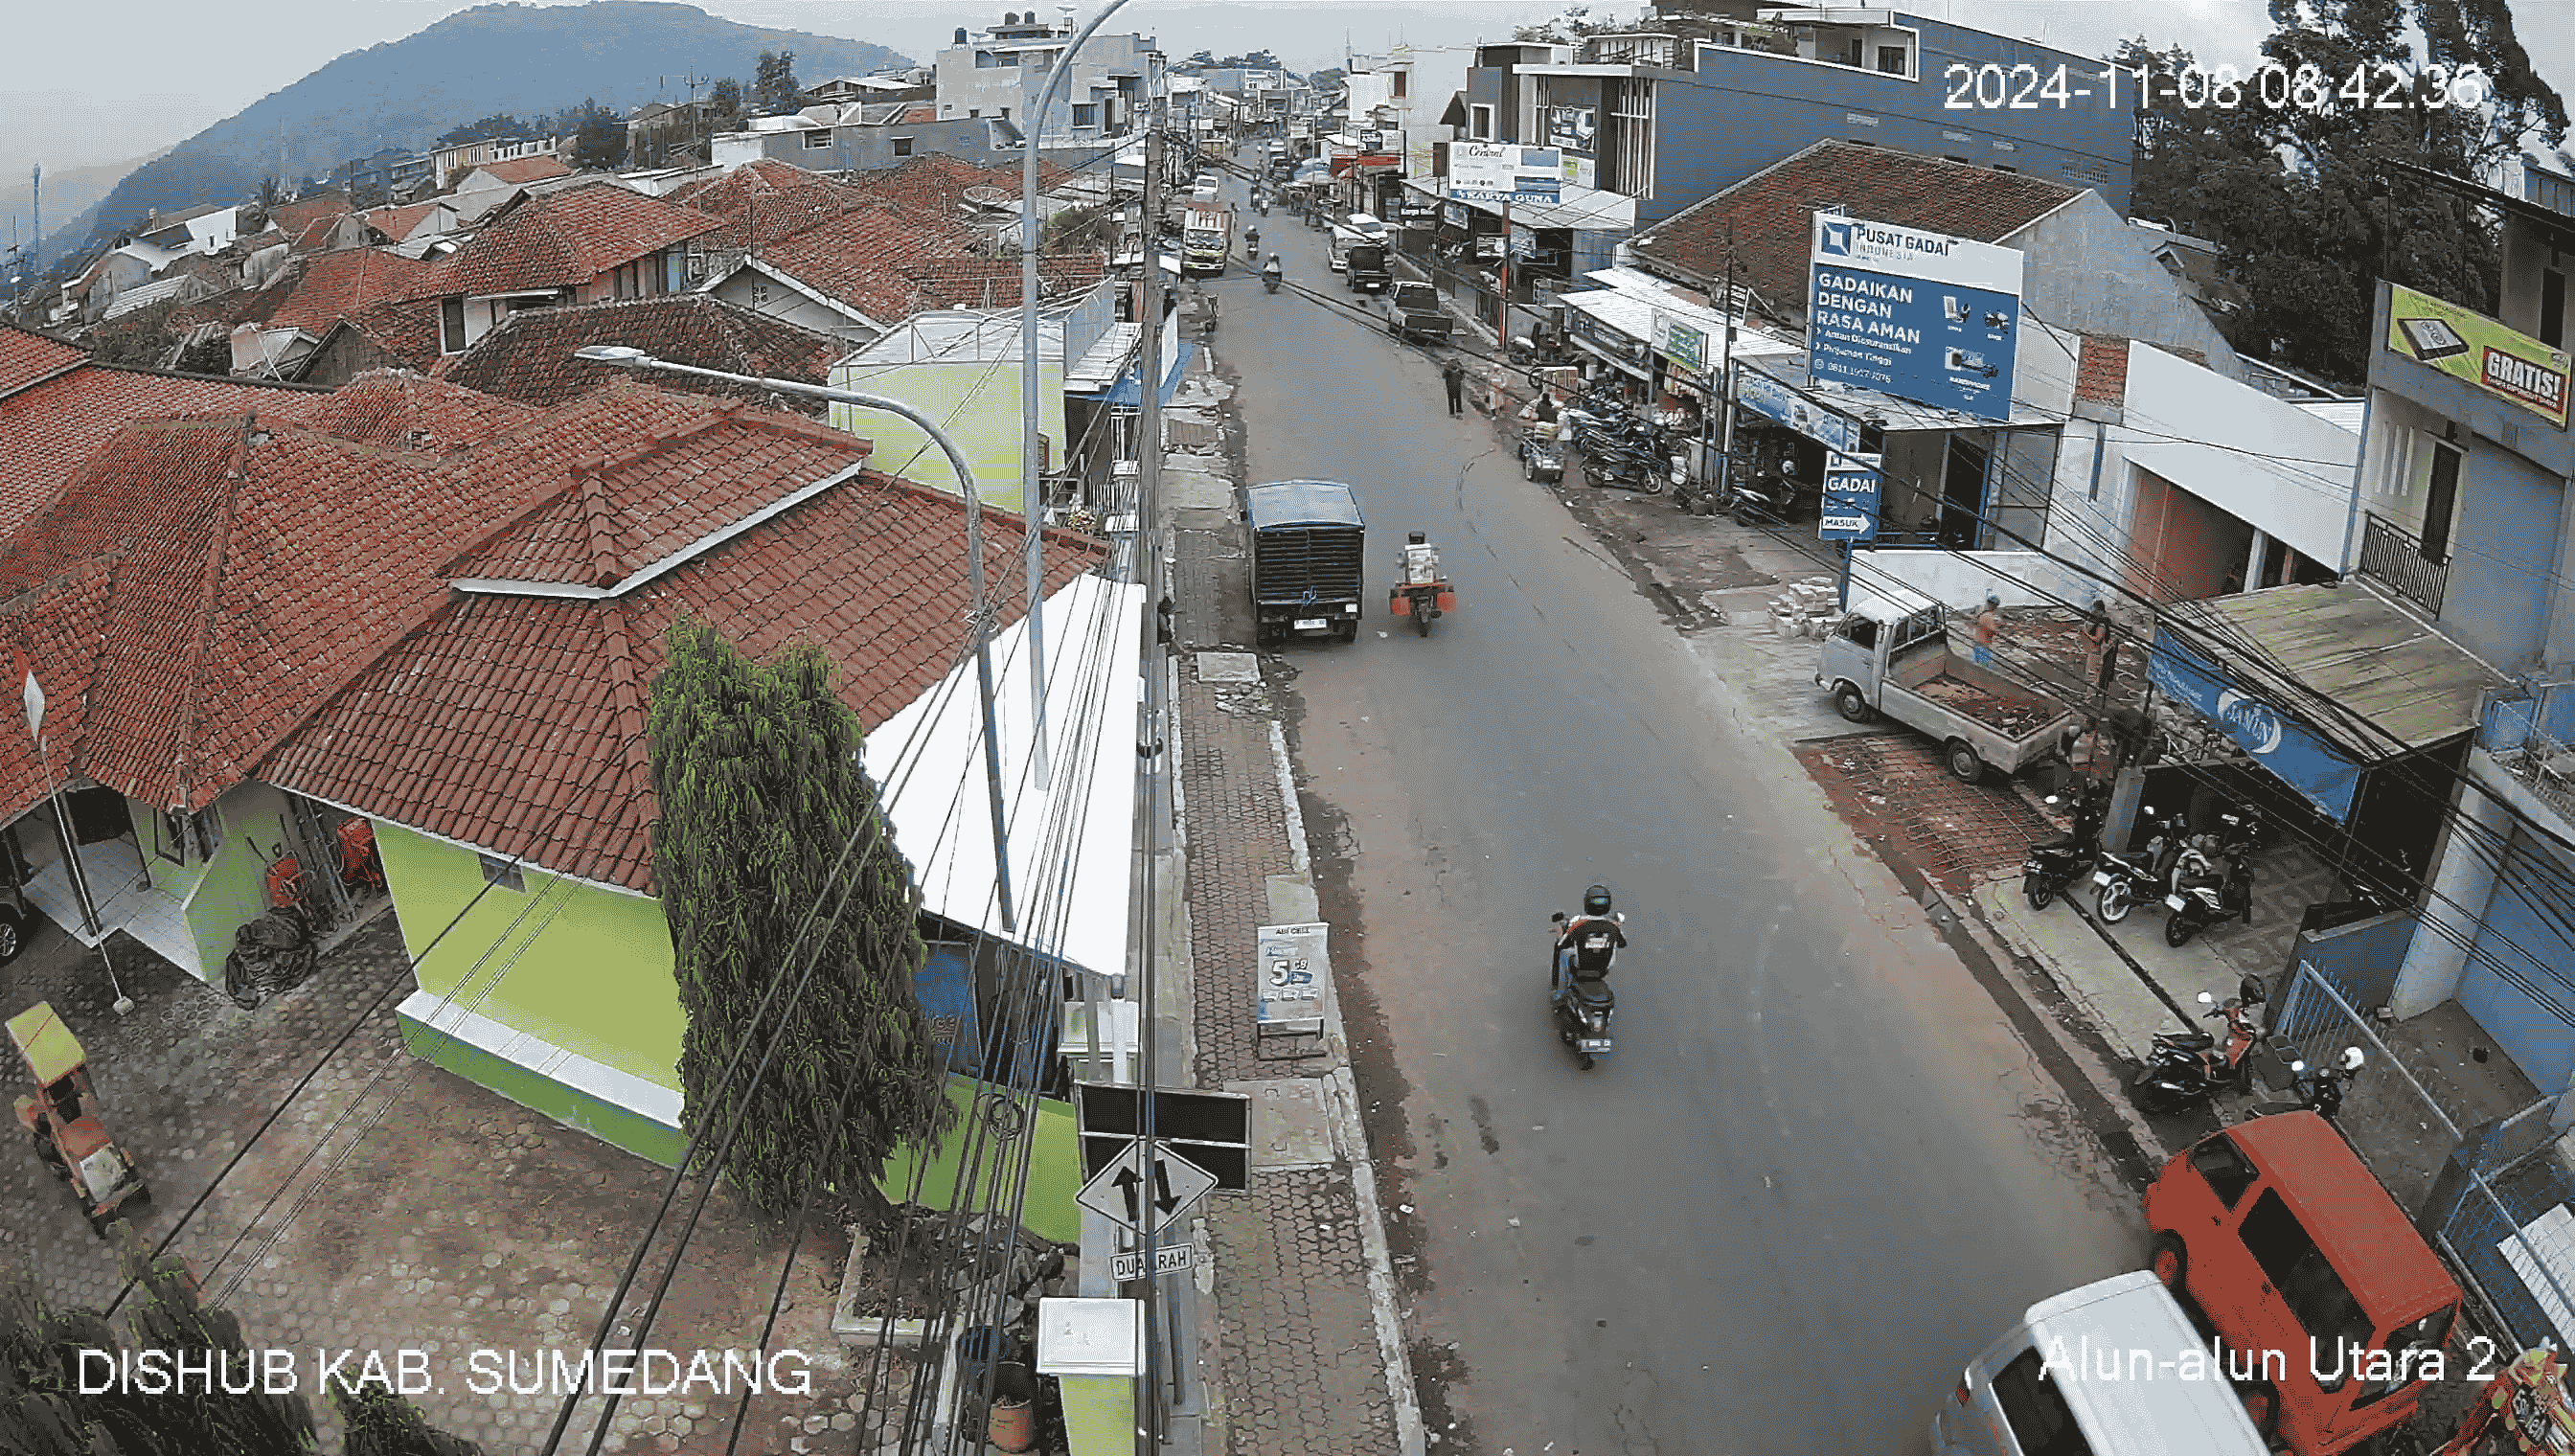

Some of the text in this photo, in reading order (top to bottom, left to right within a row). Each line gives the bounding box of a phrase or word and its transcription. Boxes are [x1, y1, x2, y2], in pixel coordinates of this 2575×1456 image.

[1857, 227, 1949, 257] PUSAT GADAI
[1818, 273, 1912, 304] GADAIKAN
[1818, 291, 1892, 319] DENGAN
[1817, 310, 1921, 344] RASA AMAN
[2487, 352, 2562, 401] GRATIS!
[1828, 477, 1876, 493] GADAI
[1269, 959, 1290, 987] 5
[1116, 1250, 1187, 1277] DUA RAH
